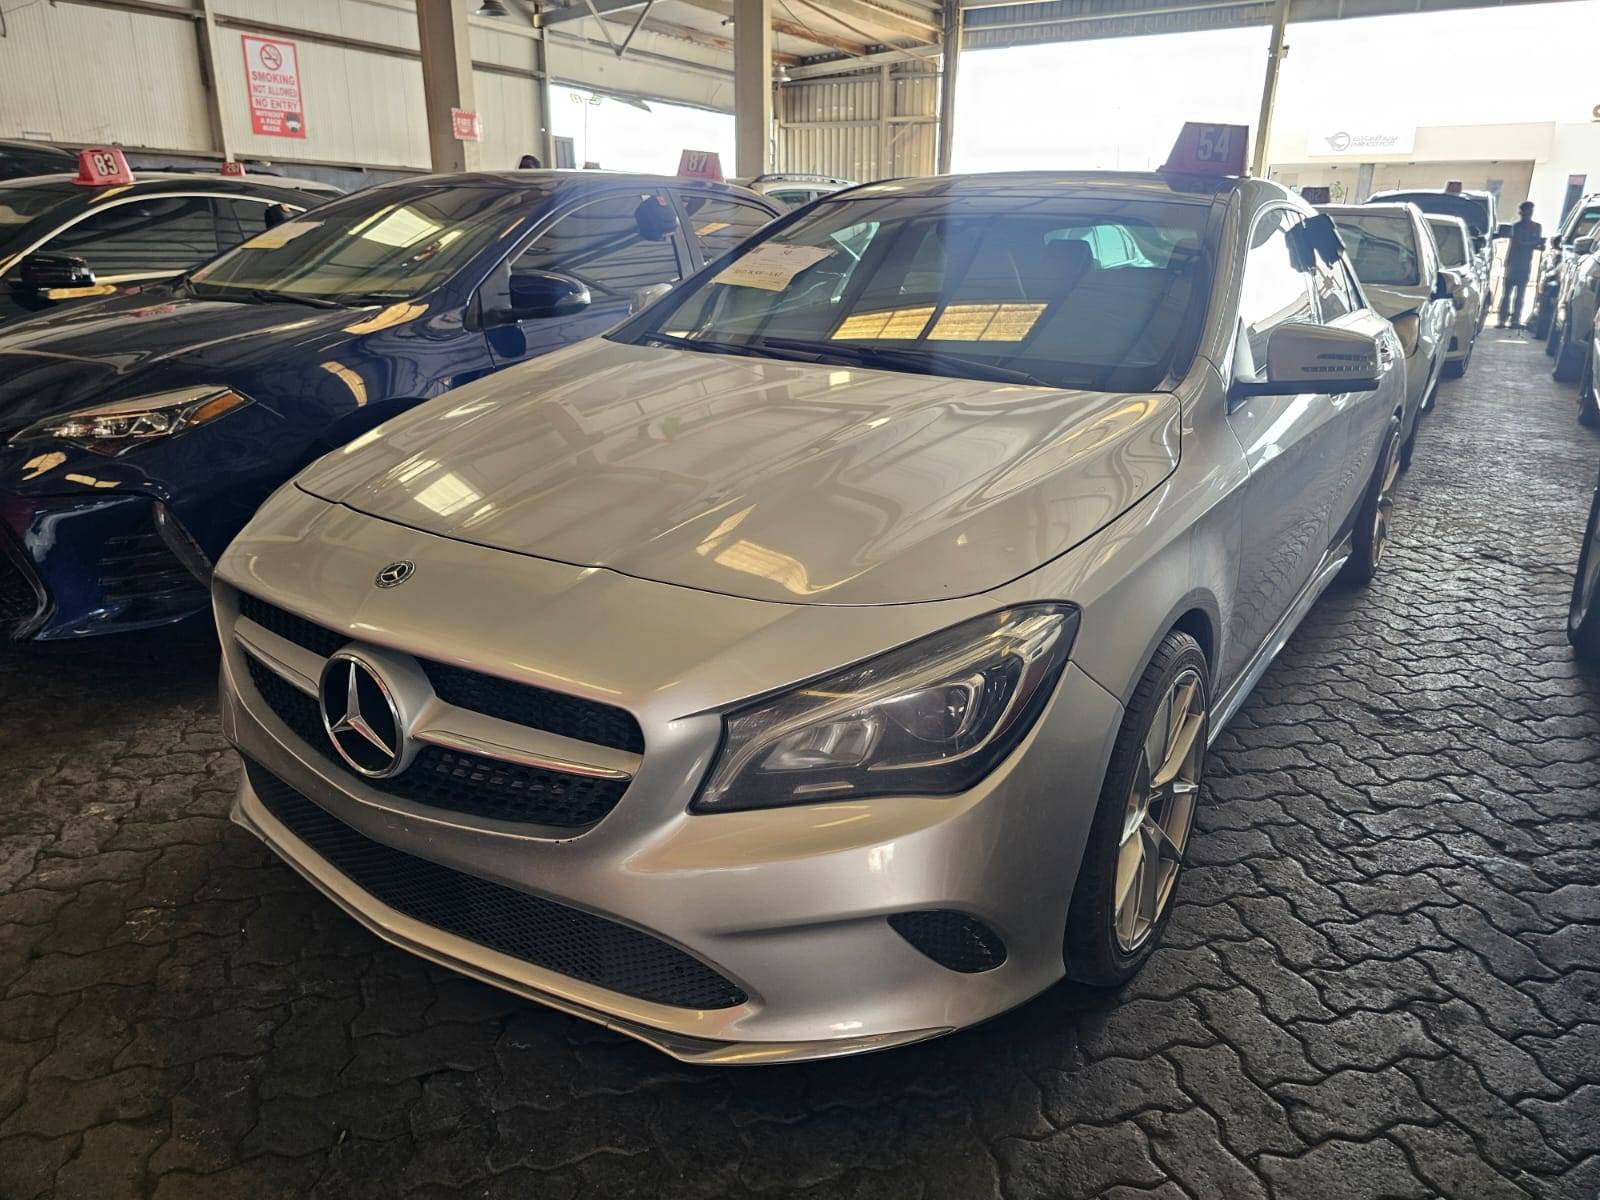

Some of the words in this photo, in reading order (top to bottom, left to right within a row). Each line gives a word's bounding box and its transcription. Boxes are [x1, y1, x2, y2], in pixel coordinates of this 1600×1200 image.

[252, 71, 295, 85] SMOKING
[253, 84, 266, 94] NOT
[268, 86, 297, 97] ALLOWED
[255, 98, 268, 108] NO
[271, 100, 297, 111] ENTRY
[1197, 127, 1230, 161] 54
[93, 153, 119, 176] 83
[688, 151, 708, 172] 87
